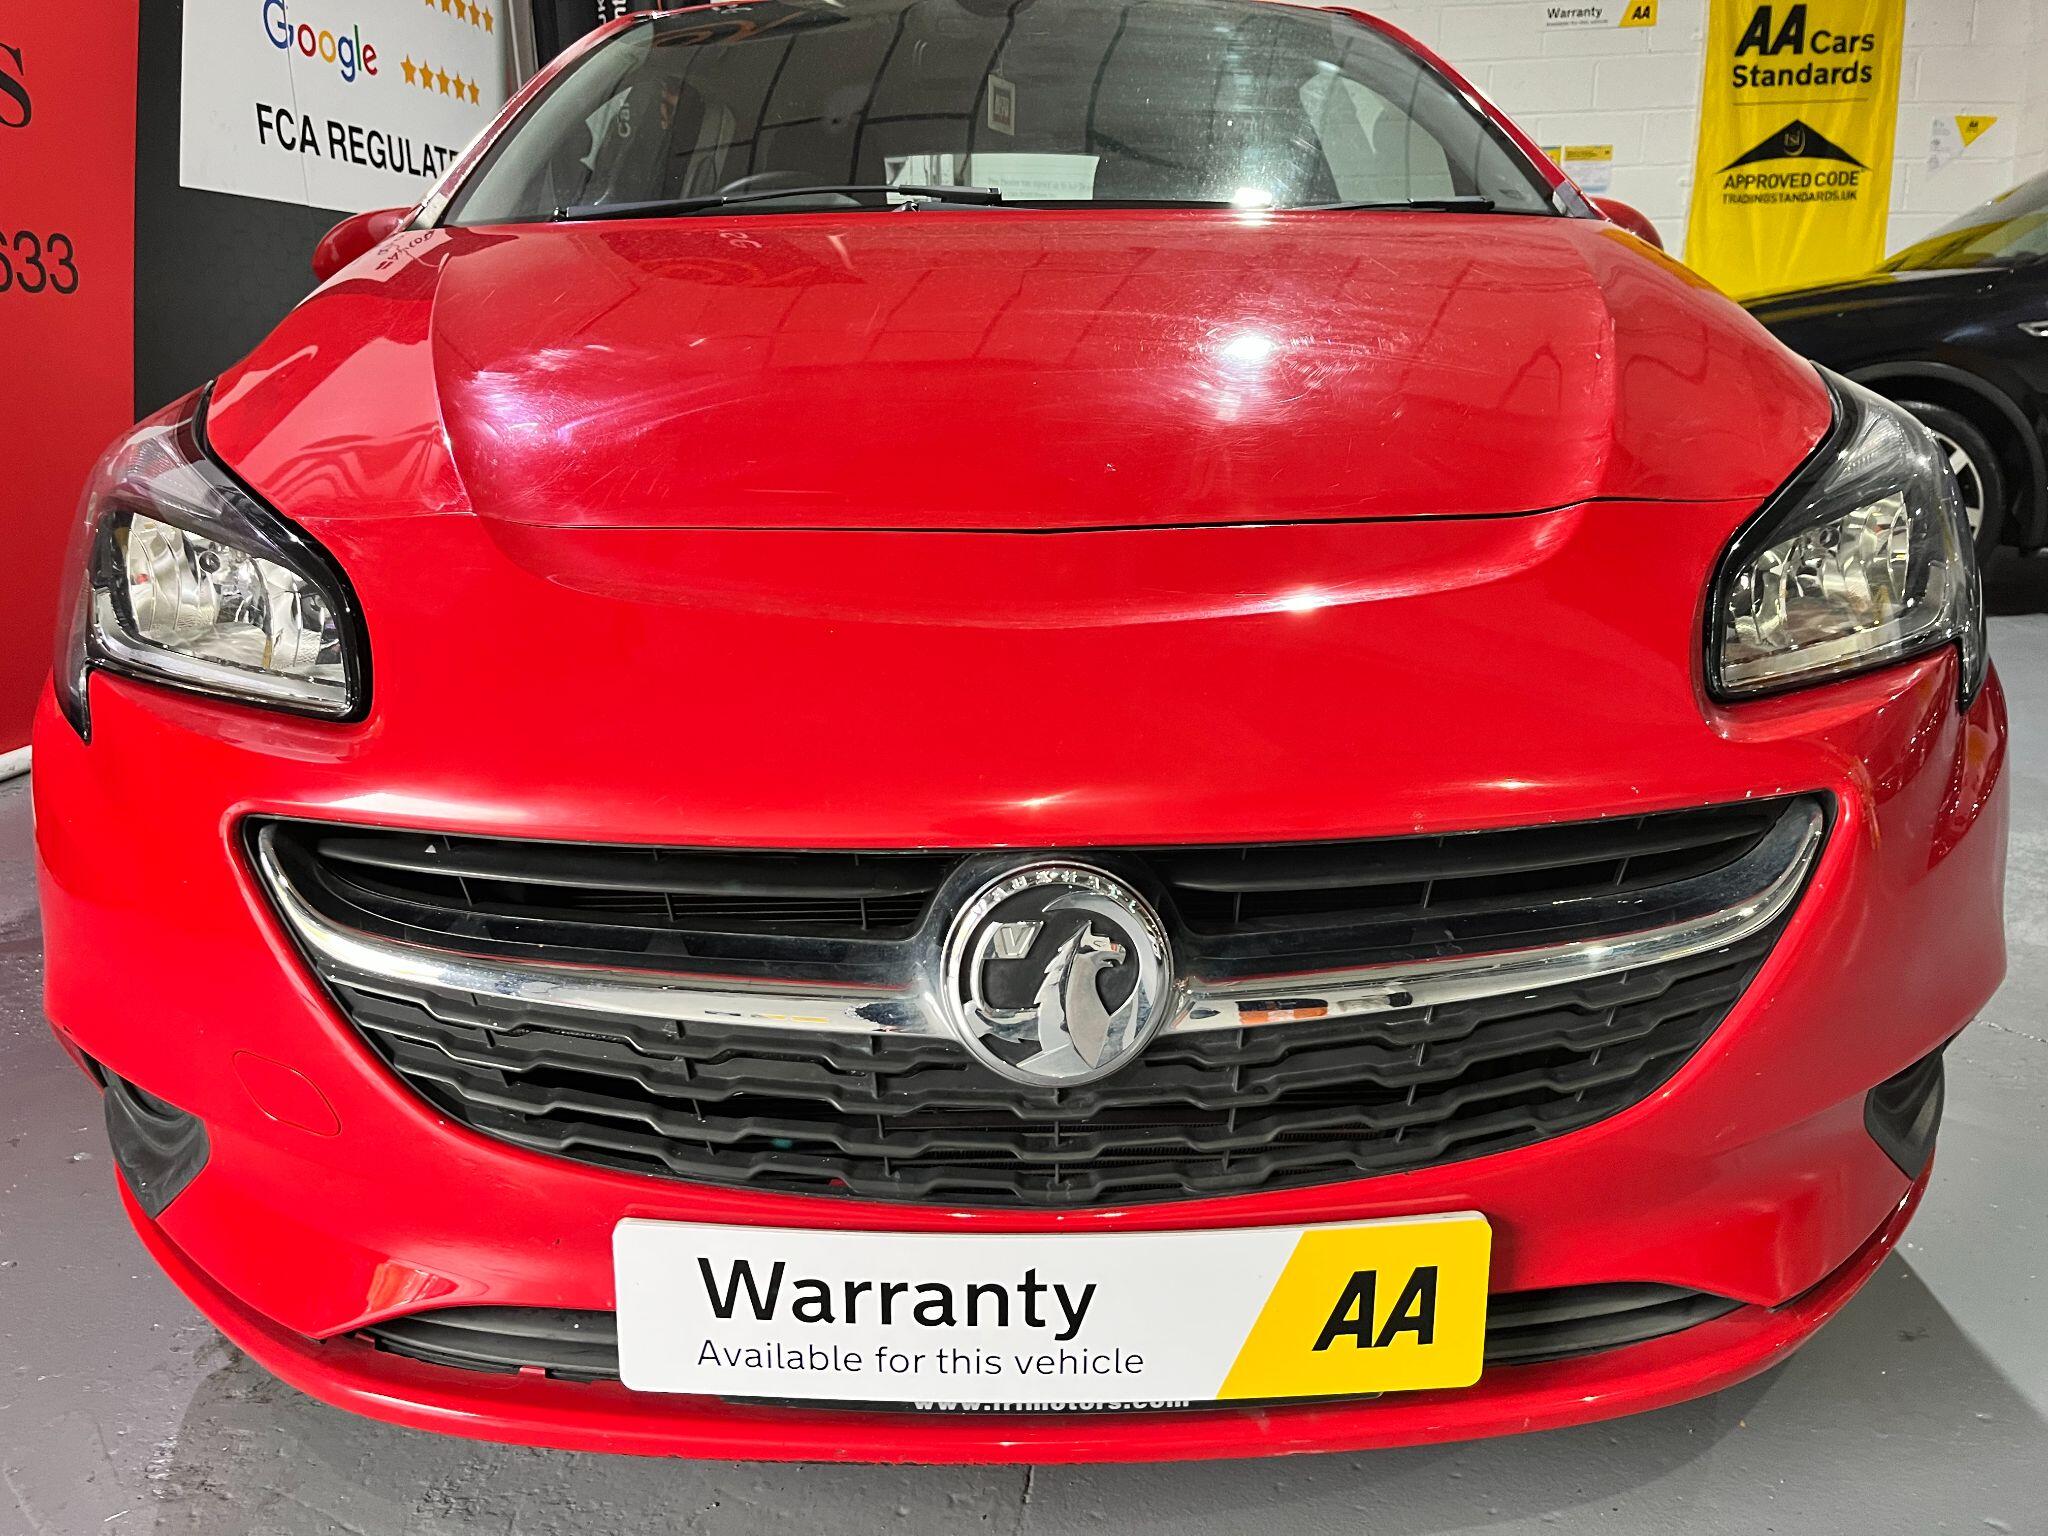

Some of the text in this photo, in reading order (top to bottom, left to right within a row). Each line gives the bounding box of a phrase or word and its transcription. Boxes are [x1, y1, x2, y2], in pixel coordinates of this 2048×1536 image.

[1547, 5, 1651, 20] Warranty AA
[1734, 4, 1875, 57] AA Cars
[262, 0, 378, 83] Google
[1732, 60, 1873, 88] Standards
[256, 102, 461, 179] FCA REGULAT
[1723, 170, 1860, 190] APPROVED CODE
[696, 1256, 1438, 1351] Warranty AA
[697, 1339, 1145, 1376] Available for this vehicle
